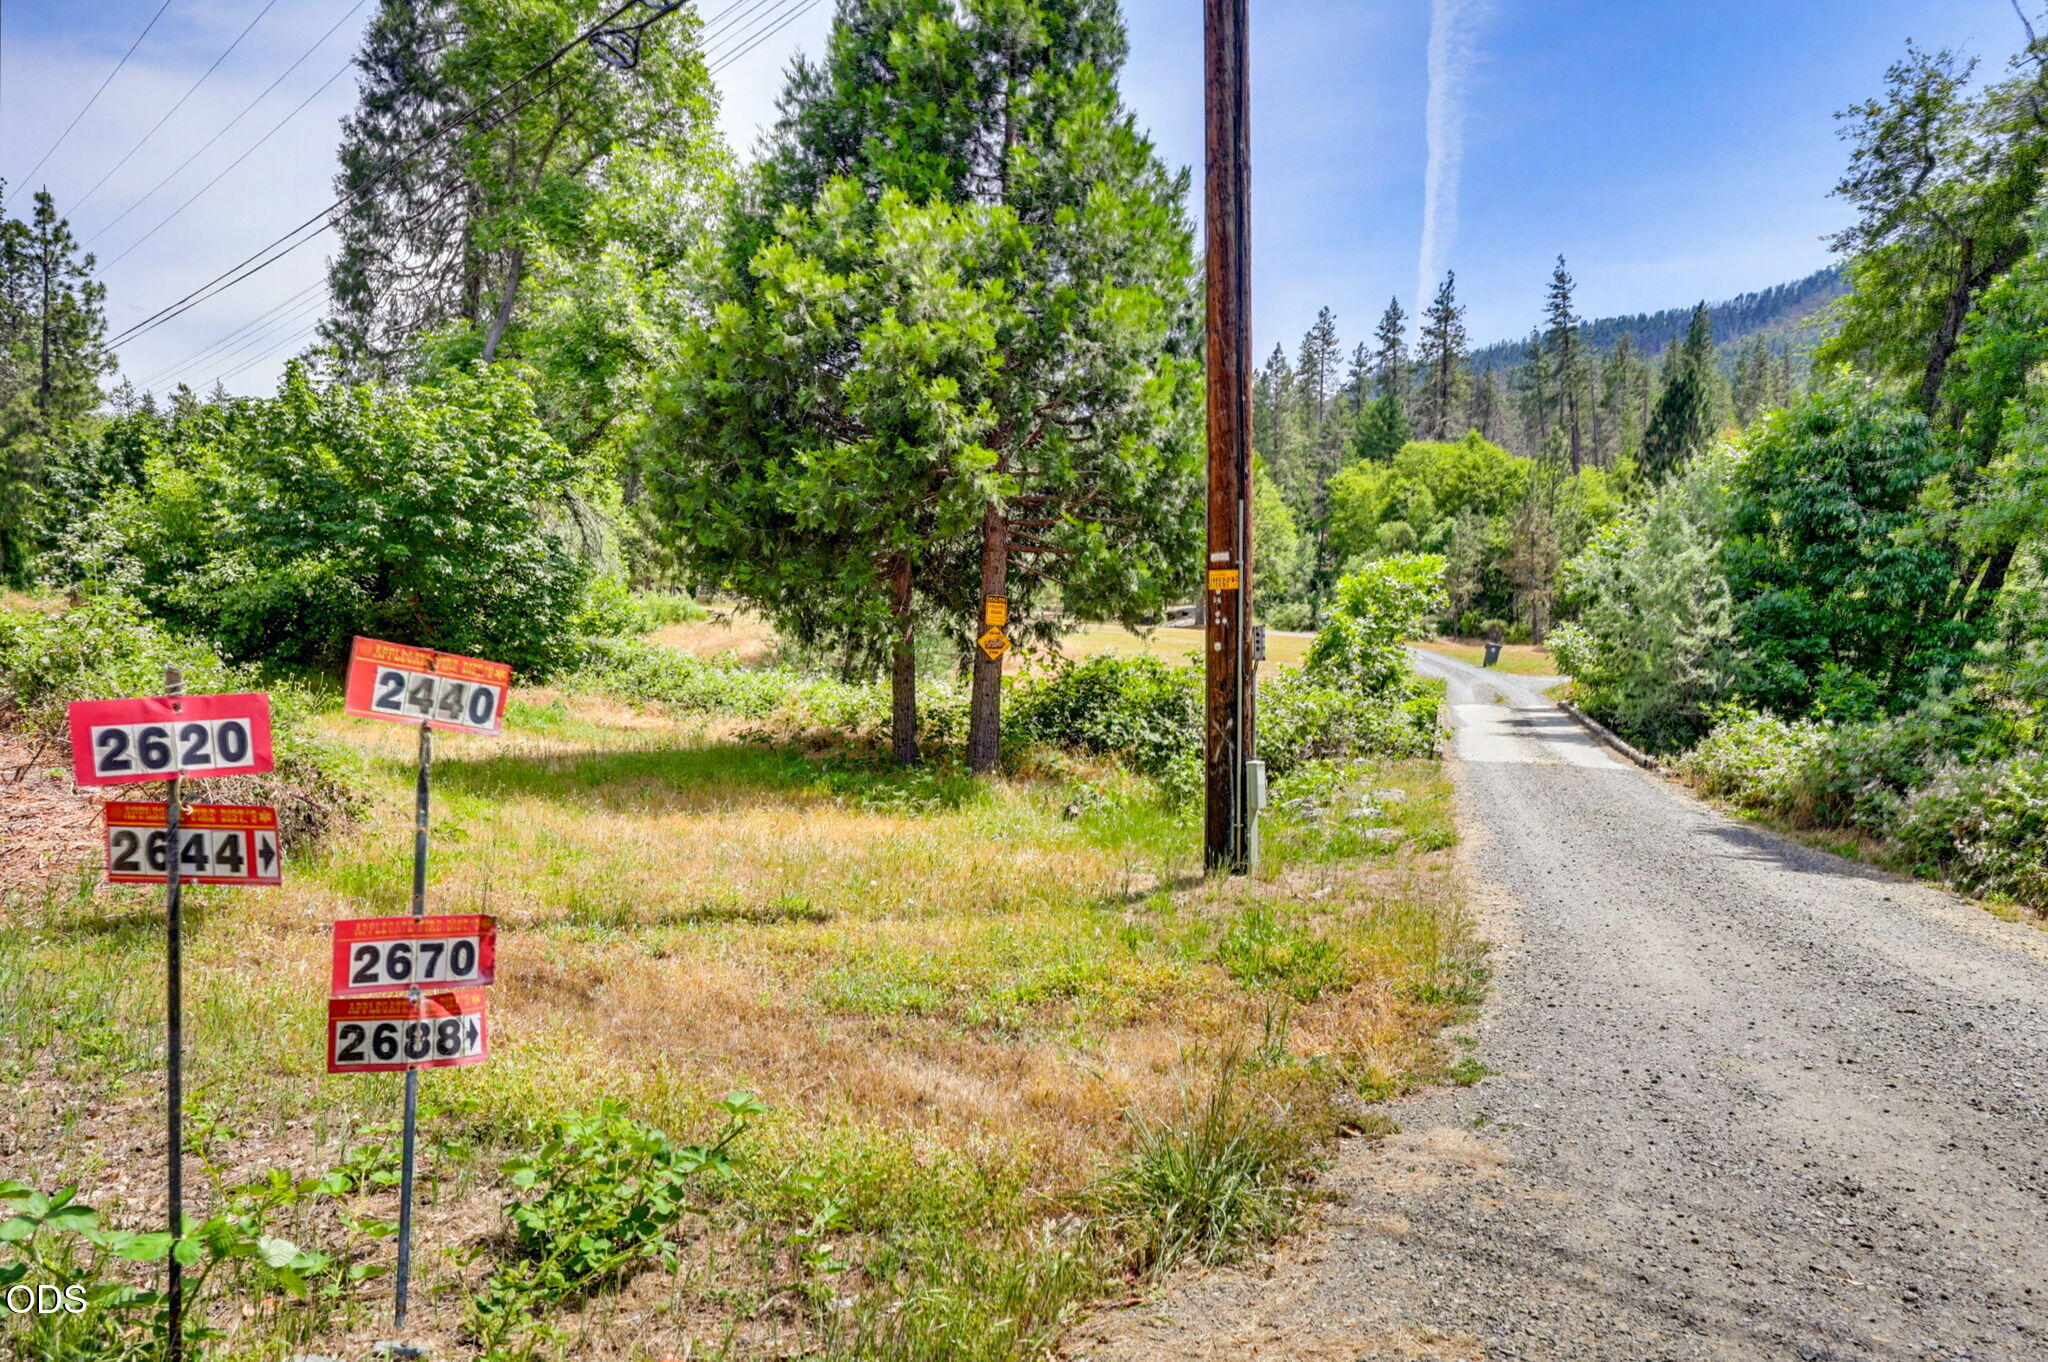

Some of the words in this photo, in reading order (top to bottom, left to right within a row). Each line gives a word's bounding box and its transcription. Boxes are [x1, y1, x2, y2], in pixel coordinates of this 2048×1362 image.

[375, 671, 495, 724] 2440
[96, 720, 249, 771] 2620
[111, 830, 245, 873] 2644
[351, 939, 476, 984] 2670
[337, 1018, 462, 1062] 2688
